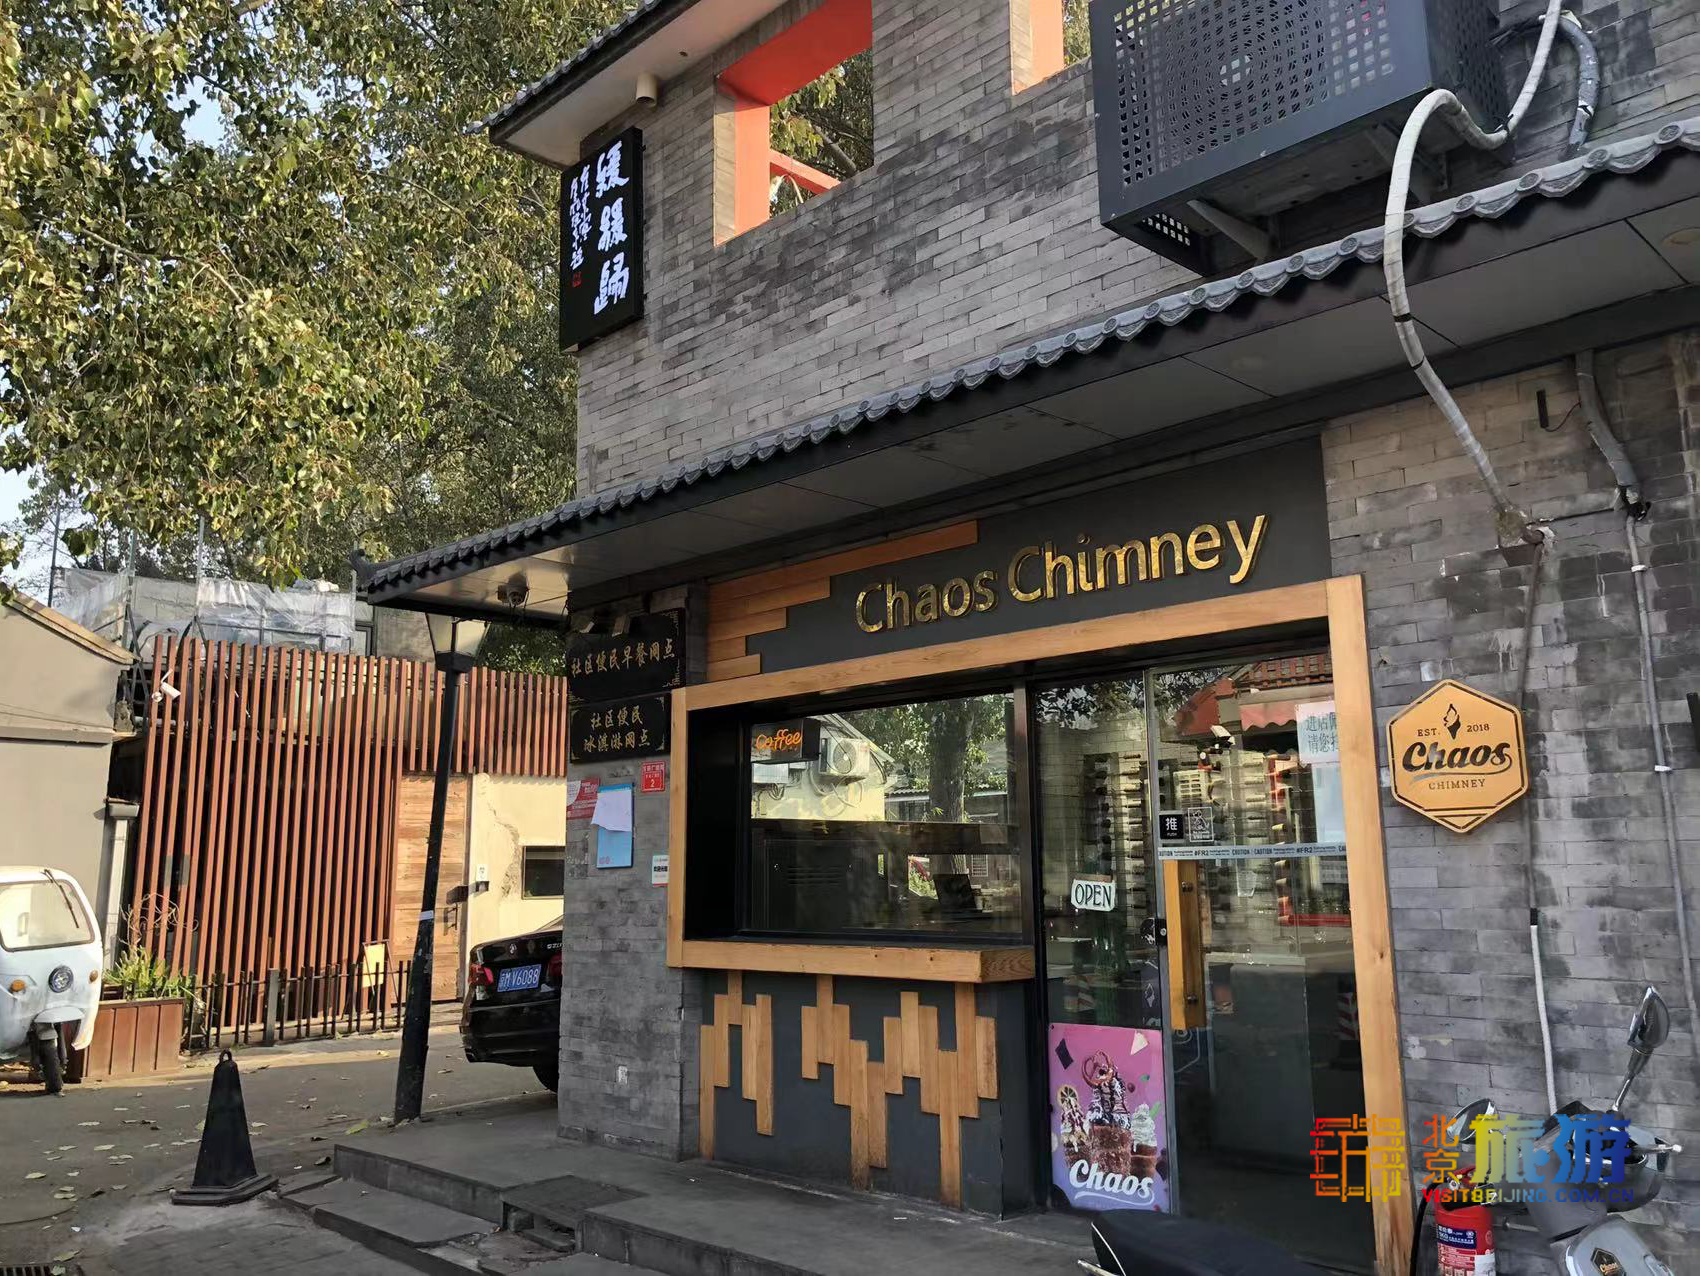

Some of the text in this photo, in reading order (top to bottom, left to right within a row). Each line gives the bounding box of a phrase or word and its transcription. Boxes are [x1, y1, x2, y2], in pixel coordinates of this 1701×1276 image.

[855, 513, 1270, 634] Chaos Chimney
[570, 638, 675, 679] 社区便民早餐网点
[590, 705, 644, 731] 社区便民
[1417, 723, 1490, 737] EST. 2018
[583, 729, 651, 753] 冰淇淋网点
[756, 728, 802, 752] Coffee
[1402, 741, 1513, 776] Chaos
[1428, 778, 1486, 791] CHIMNEY
[1165, 817, 1178, 831] 推
[1074, 883, 1112, 908] OPEN
[1068, 1159, 1155, 1205] Chaos
